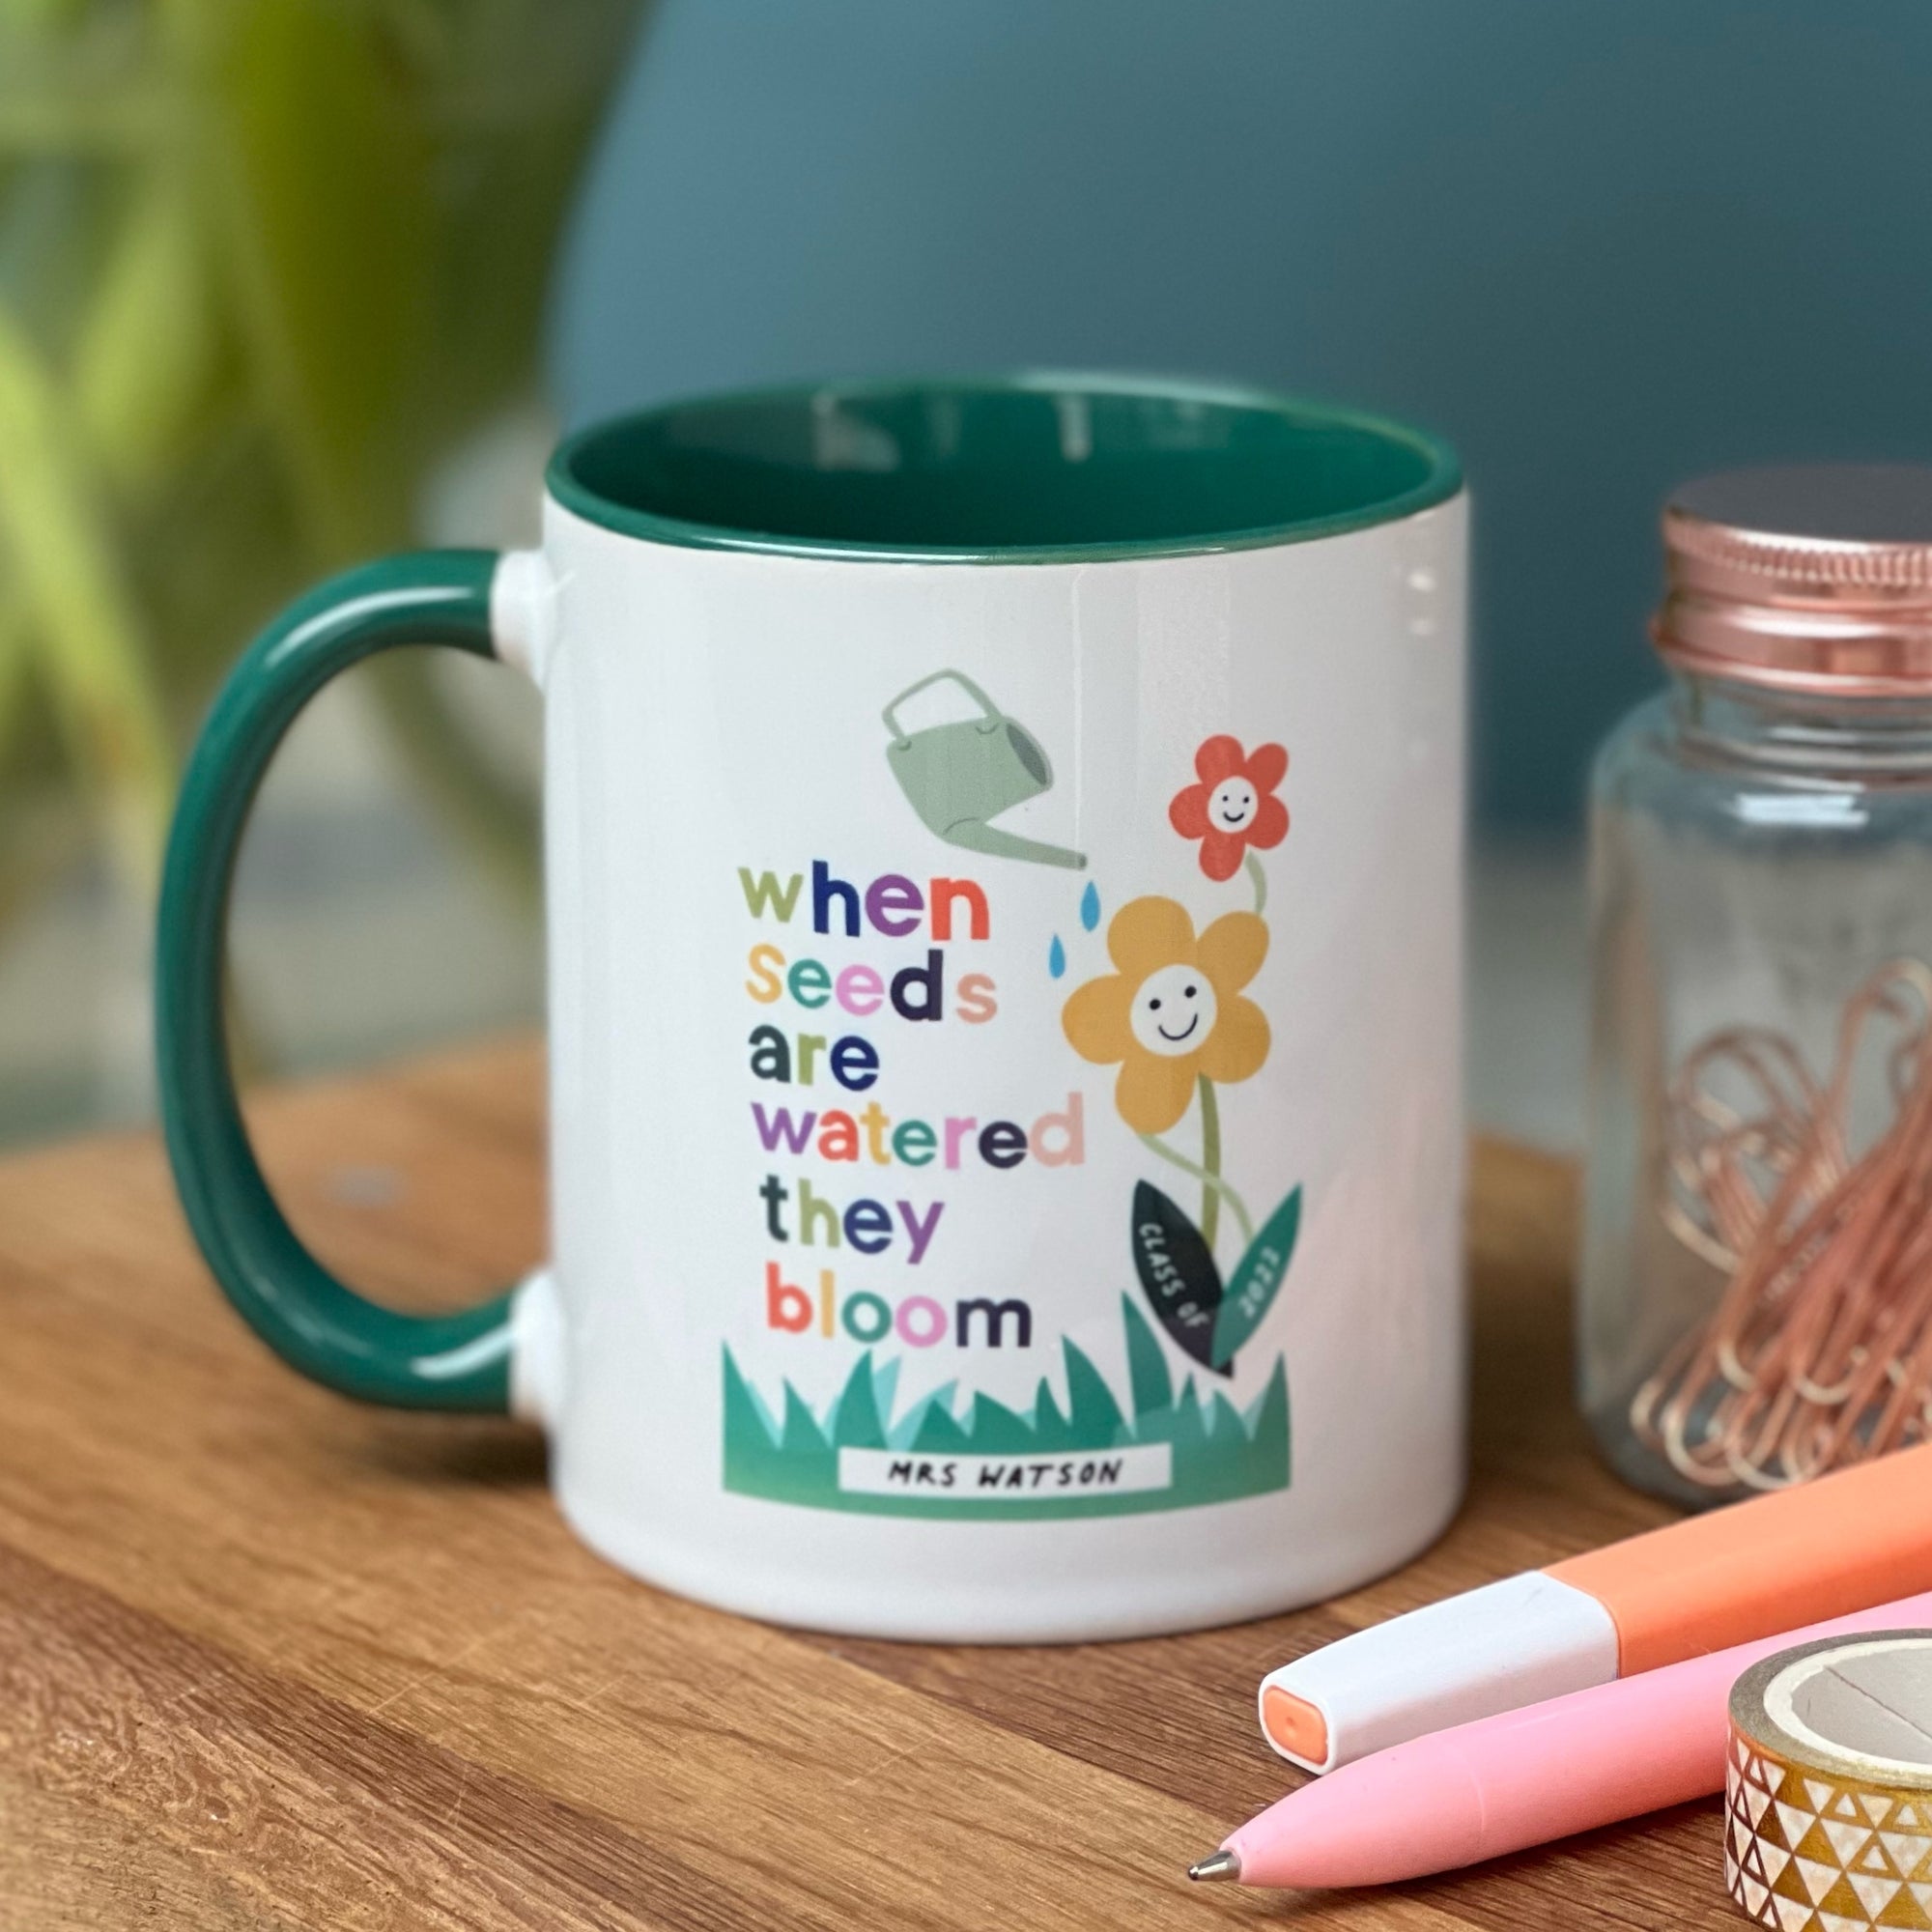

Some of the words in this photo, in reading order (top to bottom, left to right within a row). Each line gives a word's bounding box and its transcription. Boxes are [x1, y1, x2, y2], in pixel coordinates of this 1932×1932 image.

[738, 860, 990, 941] when
[746, 943, 998, 1023] seeds
[749, 1024, 880, 1092] are
[751, 1092, 1085, 1170] watered
[759, 1174, 945, 1265] they
[1139, 1223, 1185, 1297] CLASS
[766, 1261, 1033, 1349] bloom
[889, 1460, 957, 1490] MRS
[978, 1459, 1124, 1490] WATSON
